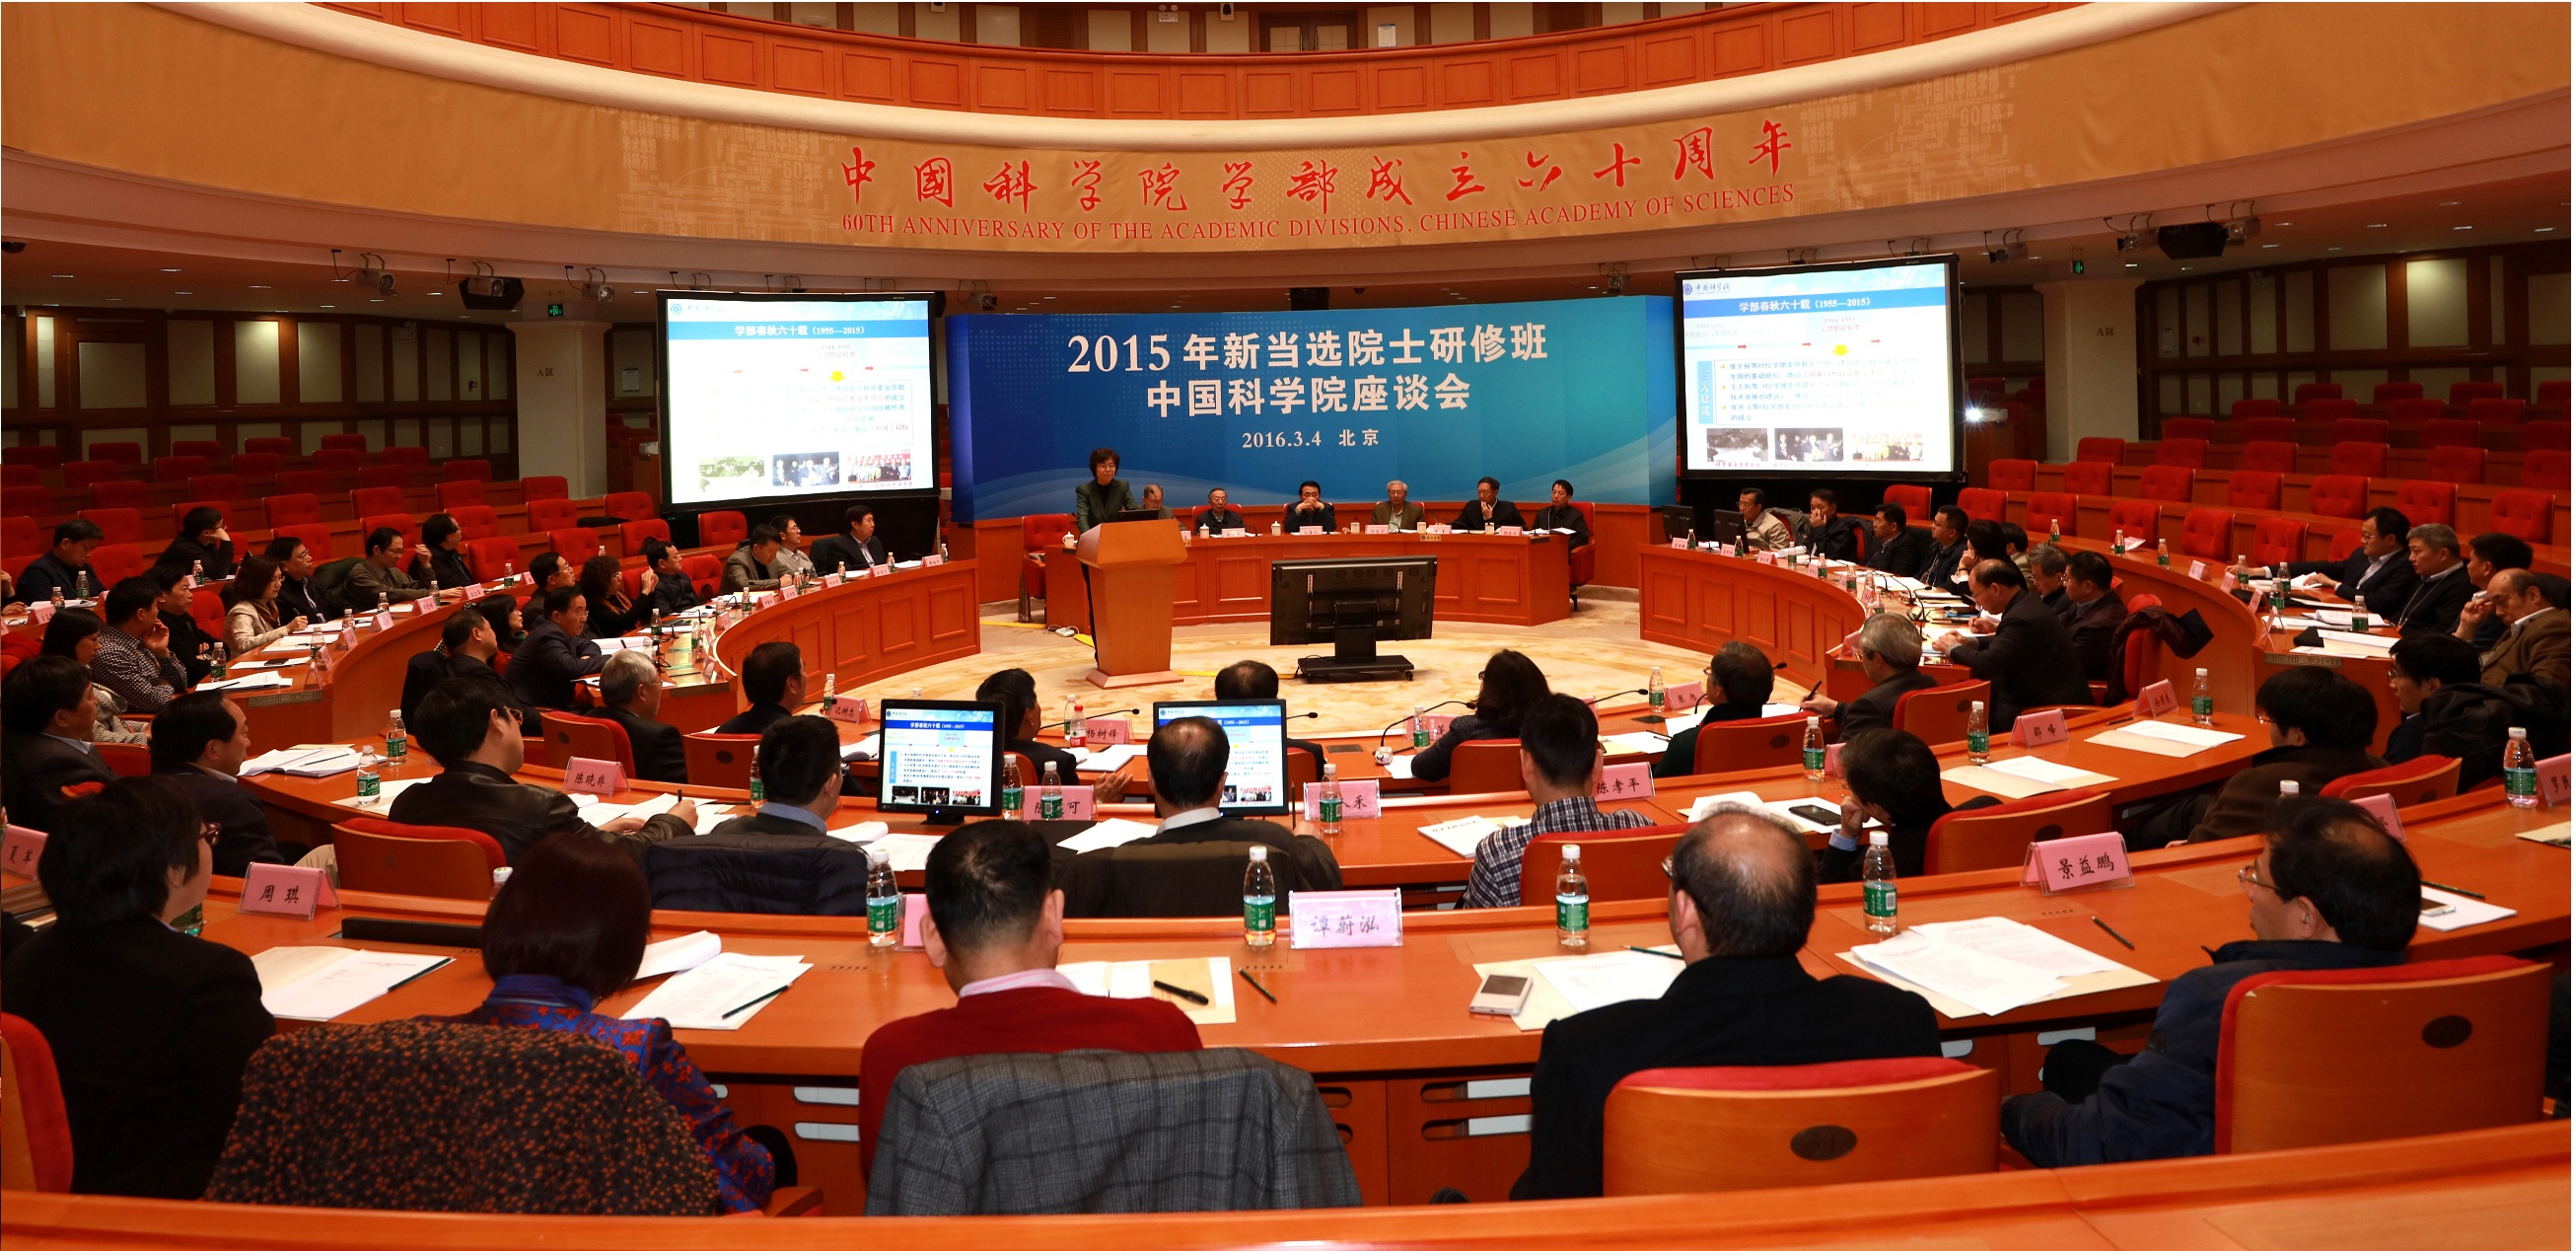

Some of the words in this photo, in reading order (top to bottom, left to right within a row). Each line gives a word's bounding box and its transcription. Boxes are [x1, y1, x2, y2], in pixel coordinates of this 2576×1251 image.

[842, 213, 894, 234] 60TH
[902, 214, 1065, 240] ANNIVERSARY
[1073, 221, 1103, 241] OF
[1109, 222, 1153, 240] THE
[1161, 220, 1281, 240] ACADEMIC
[1289, 214, 1412, 238] DIVISIONS,
[1420, 209, 1517, 232] CHINESE
[1525, 199, 1638, 227] ACADEMY
[1646, 196, 1677, 217] OF
[1682, 183, 1795, 214] SCIENCES
[537, 367, 554, 377] A区
[1147, 372, 1471, 418] 中国科学院座谈会
[1242, 431, 1323, 450] 2016.3.4
[1338, 427, 1381, 447] 北京
[1596, 776, 1640, 795] 陈孝平
[2057, 851, 2114, 880] 景益鹏
[258, 884, 300, 905] 周琪
[1310, 914, 1381, 937] 谭蔚泓
